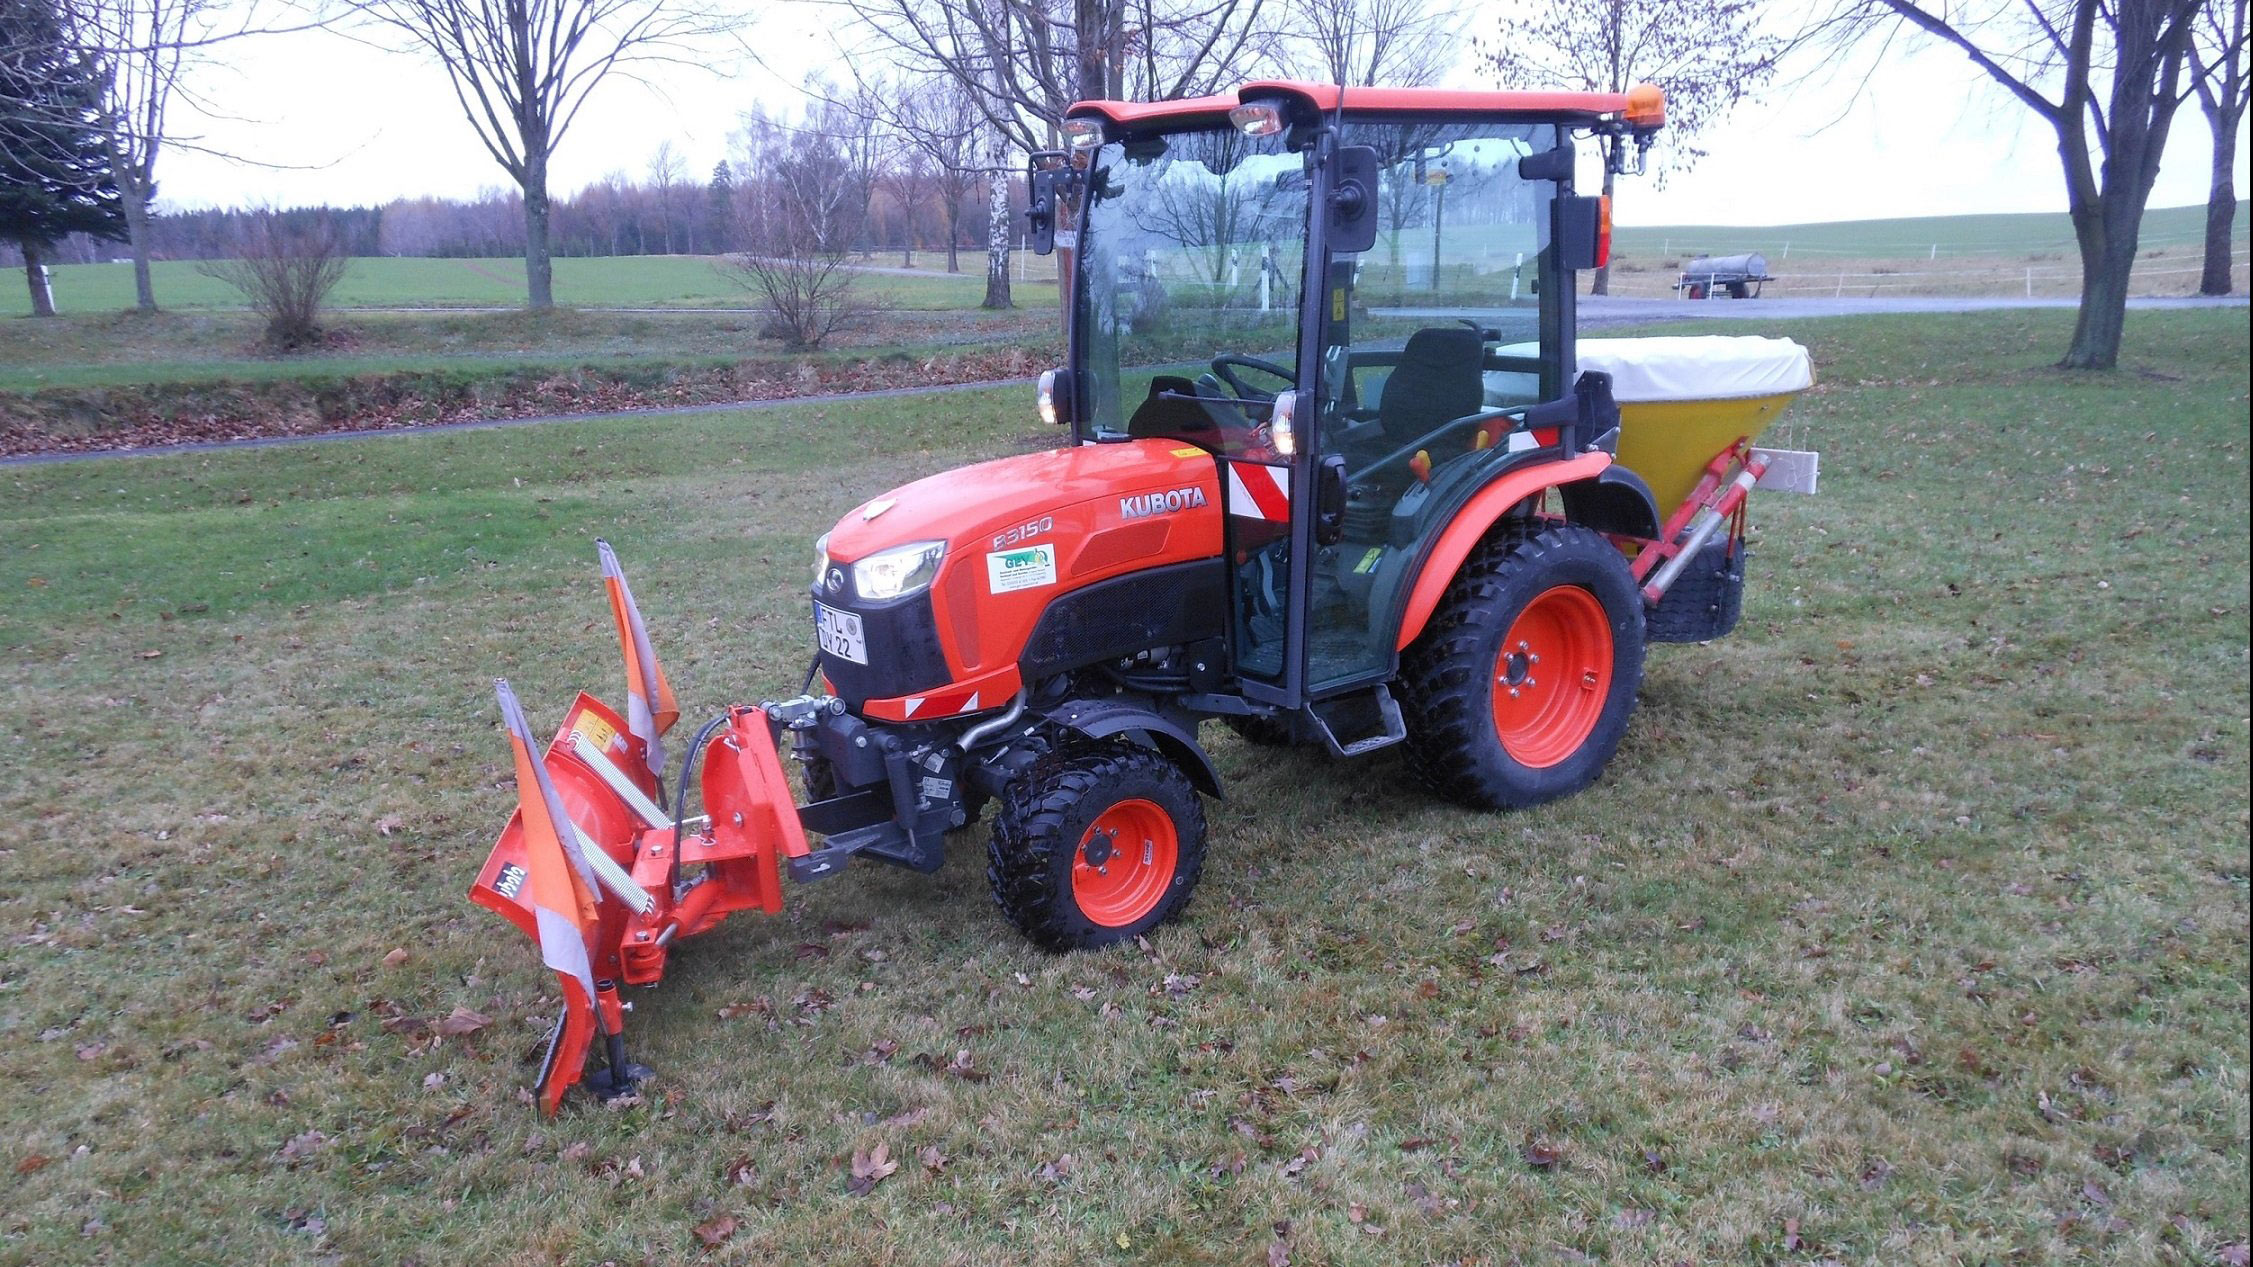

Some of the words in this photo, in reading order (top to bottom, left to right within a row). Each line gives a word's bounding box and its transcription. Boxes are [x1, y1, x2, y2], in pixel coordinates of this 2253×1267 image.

[1120, 487, 1208, 519] KUBOTA
[993, 516, 1054, 550] B3150
[835, 635, 852, 658] 22
[496, 866, 526, 898] ubota
